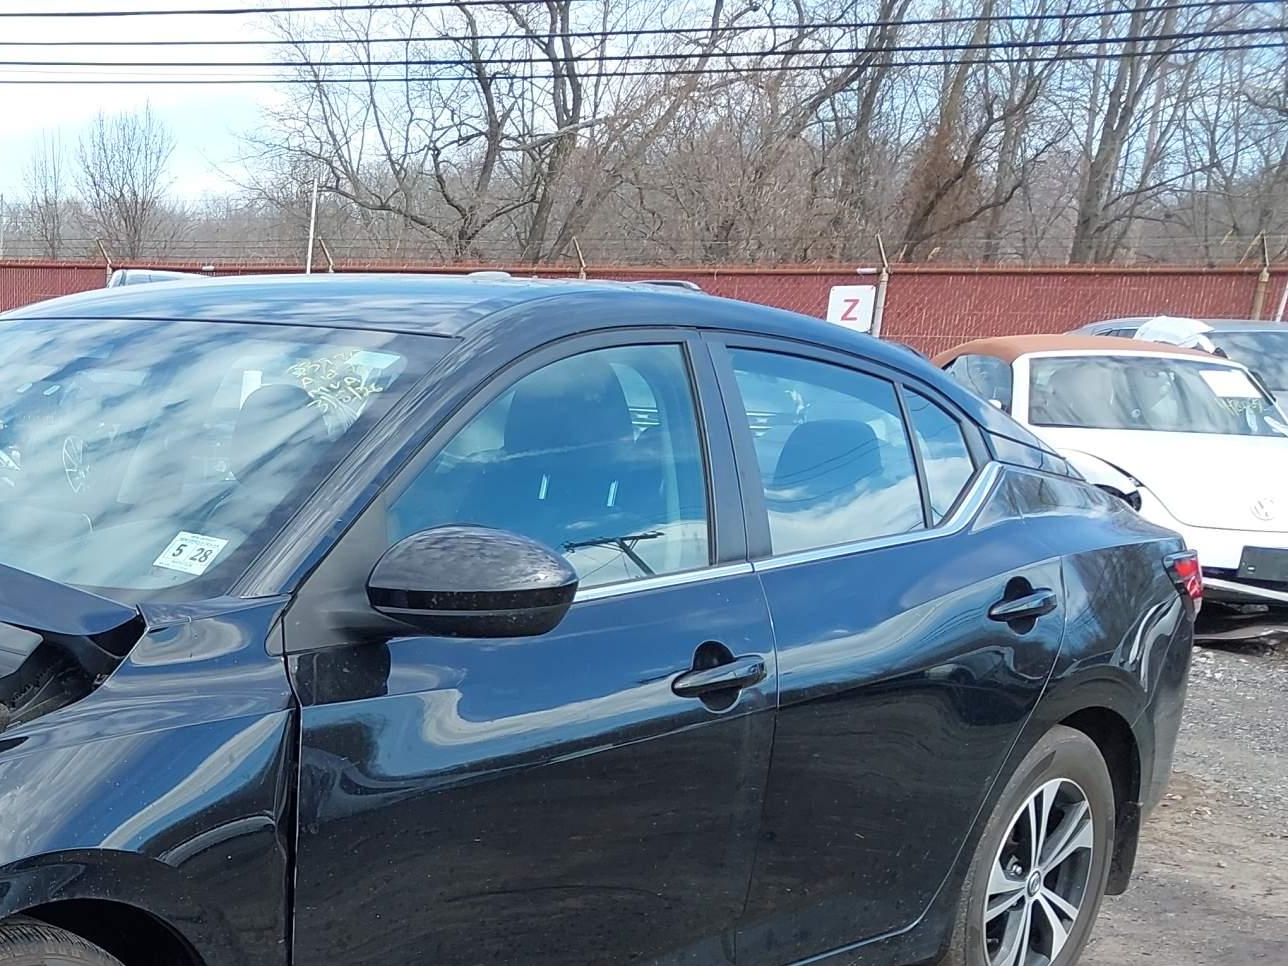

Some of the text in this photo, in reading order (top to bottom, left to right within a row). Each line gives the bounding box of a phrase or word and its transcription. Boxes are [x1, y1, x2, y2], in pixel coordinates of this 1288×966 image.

[840, 299, 860, 321] Z
[172, 543, 213, 563] 5 28
